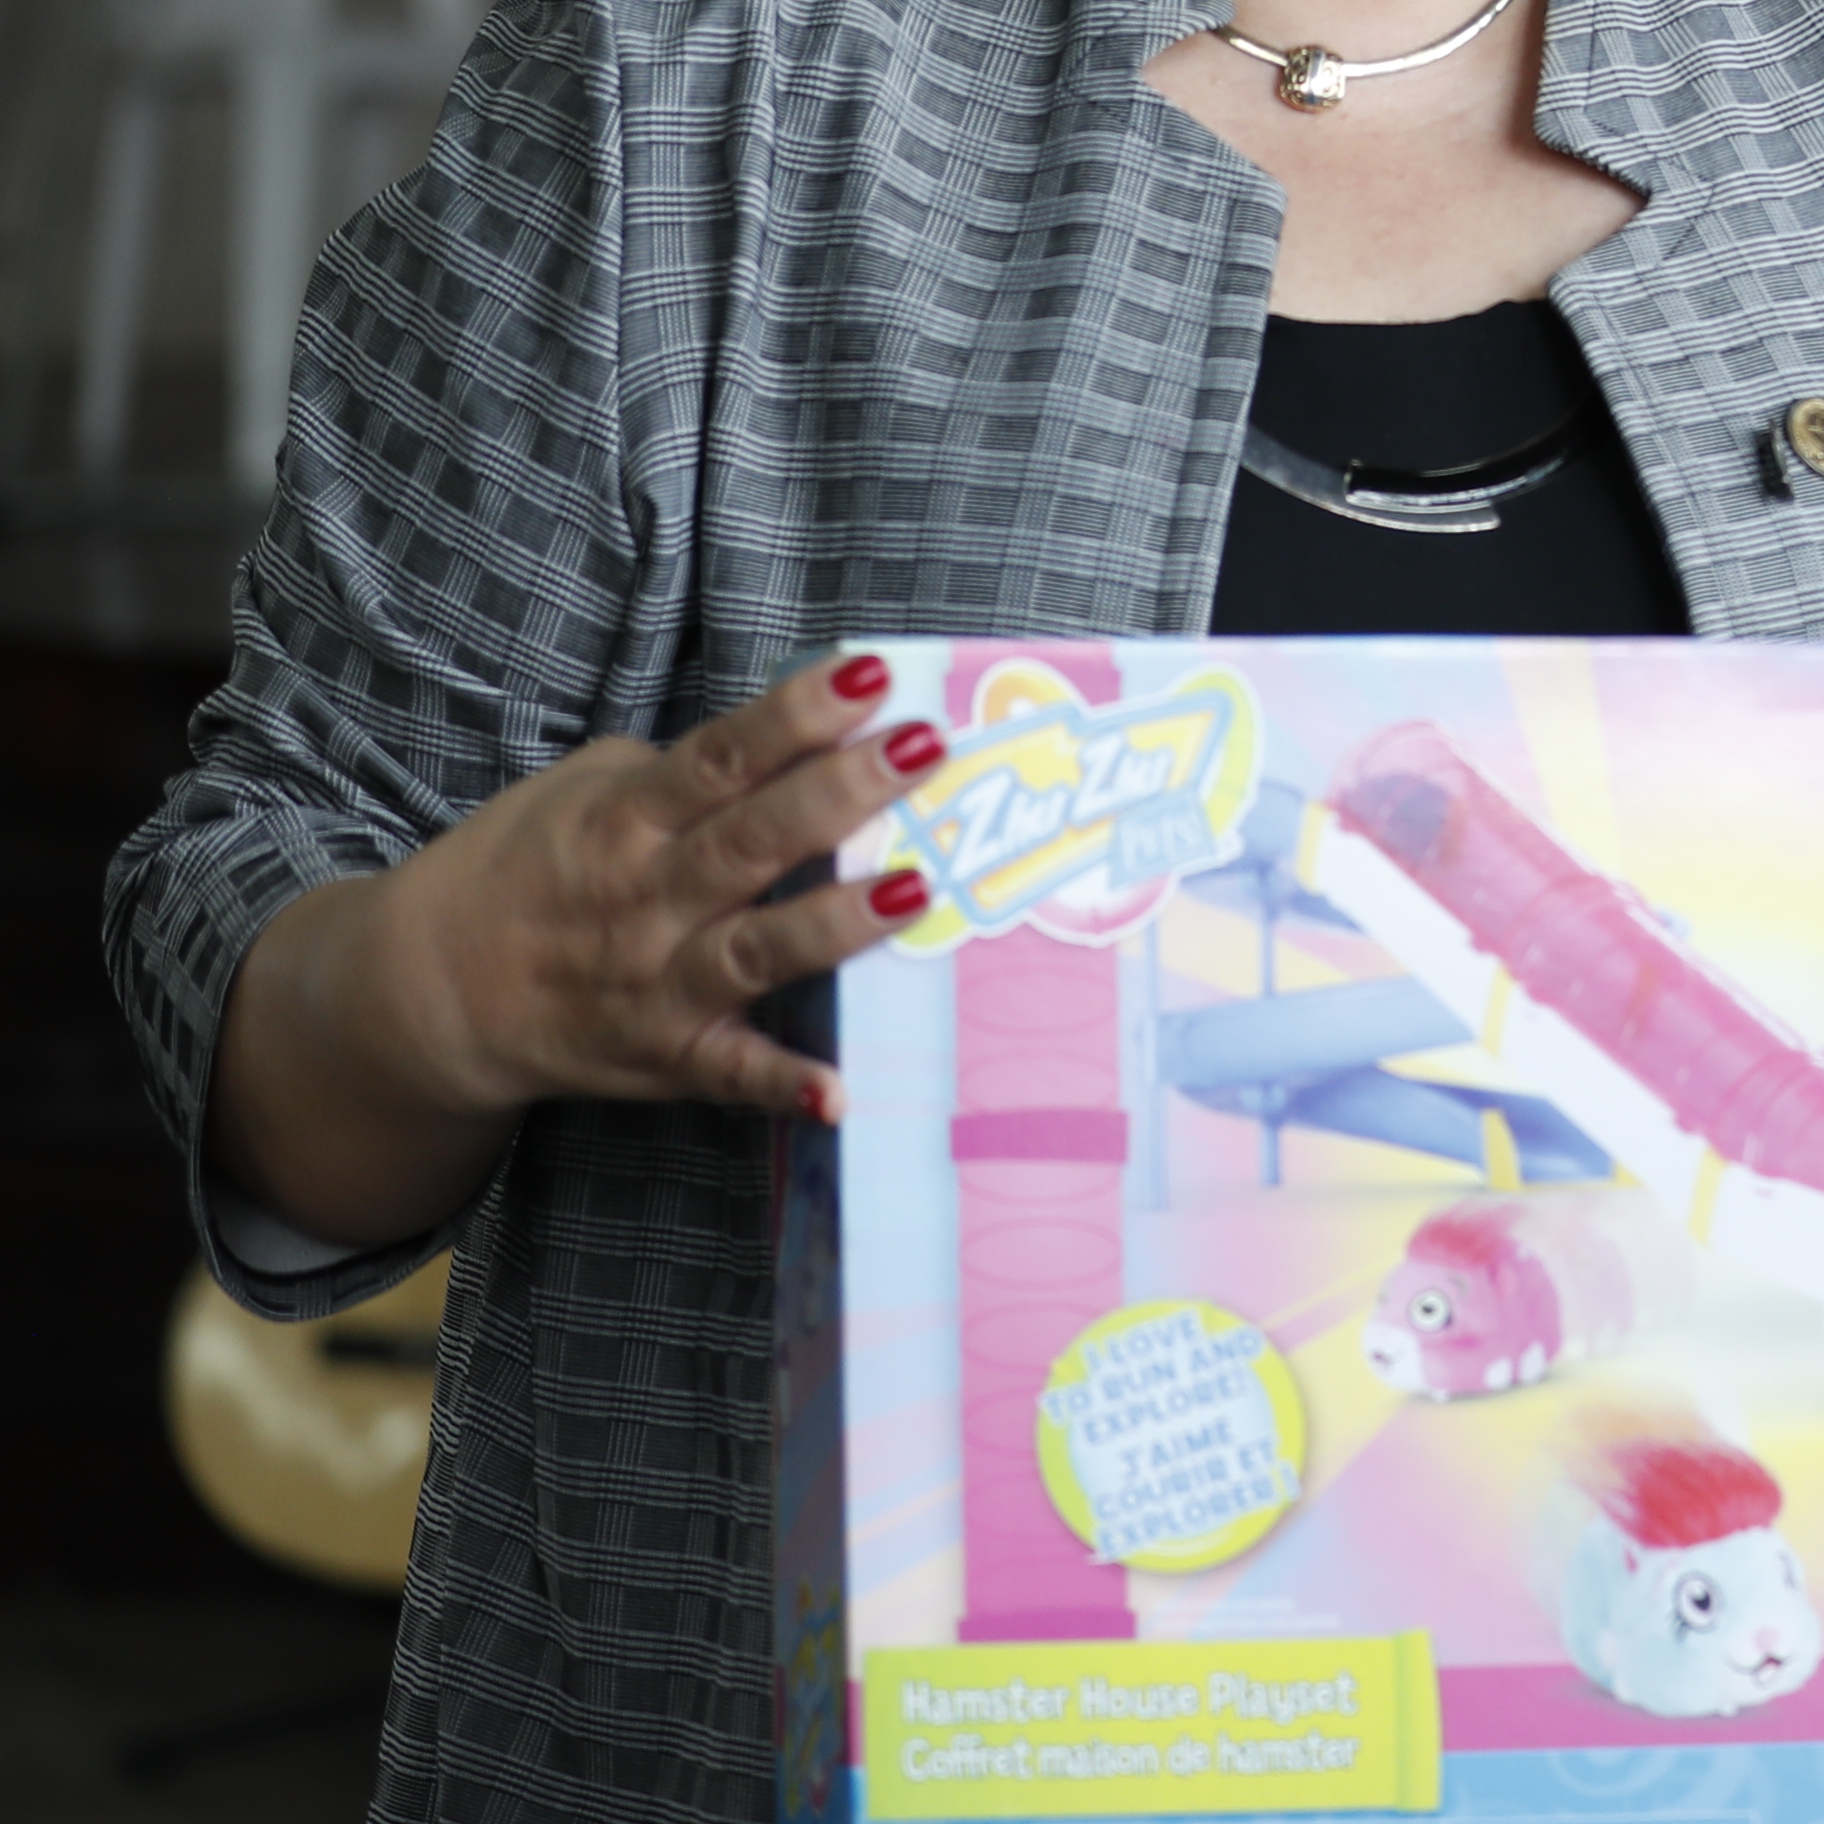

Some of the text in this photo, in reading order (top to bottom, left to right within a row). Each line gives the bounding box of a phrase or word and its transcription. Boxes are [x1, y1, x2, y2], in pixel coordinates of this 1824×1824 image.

[1107, 1315, 1197, 1365] LOVE
[1045, 1333, 1257, 1421] TO RUN AND
[1098, 1440, 1274, 1521] COURIR ET
[903, 1671, 1358, 1725] Hamster House Playset
[904, 1729, 1359, 1781] Coffret maison de hamster
